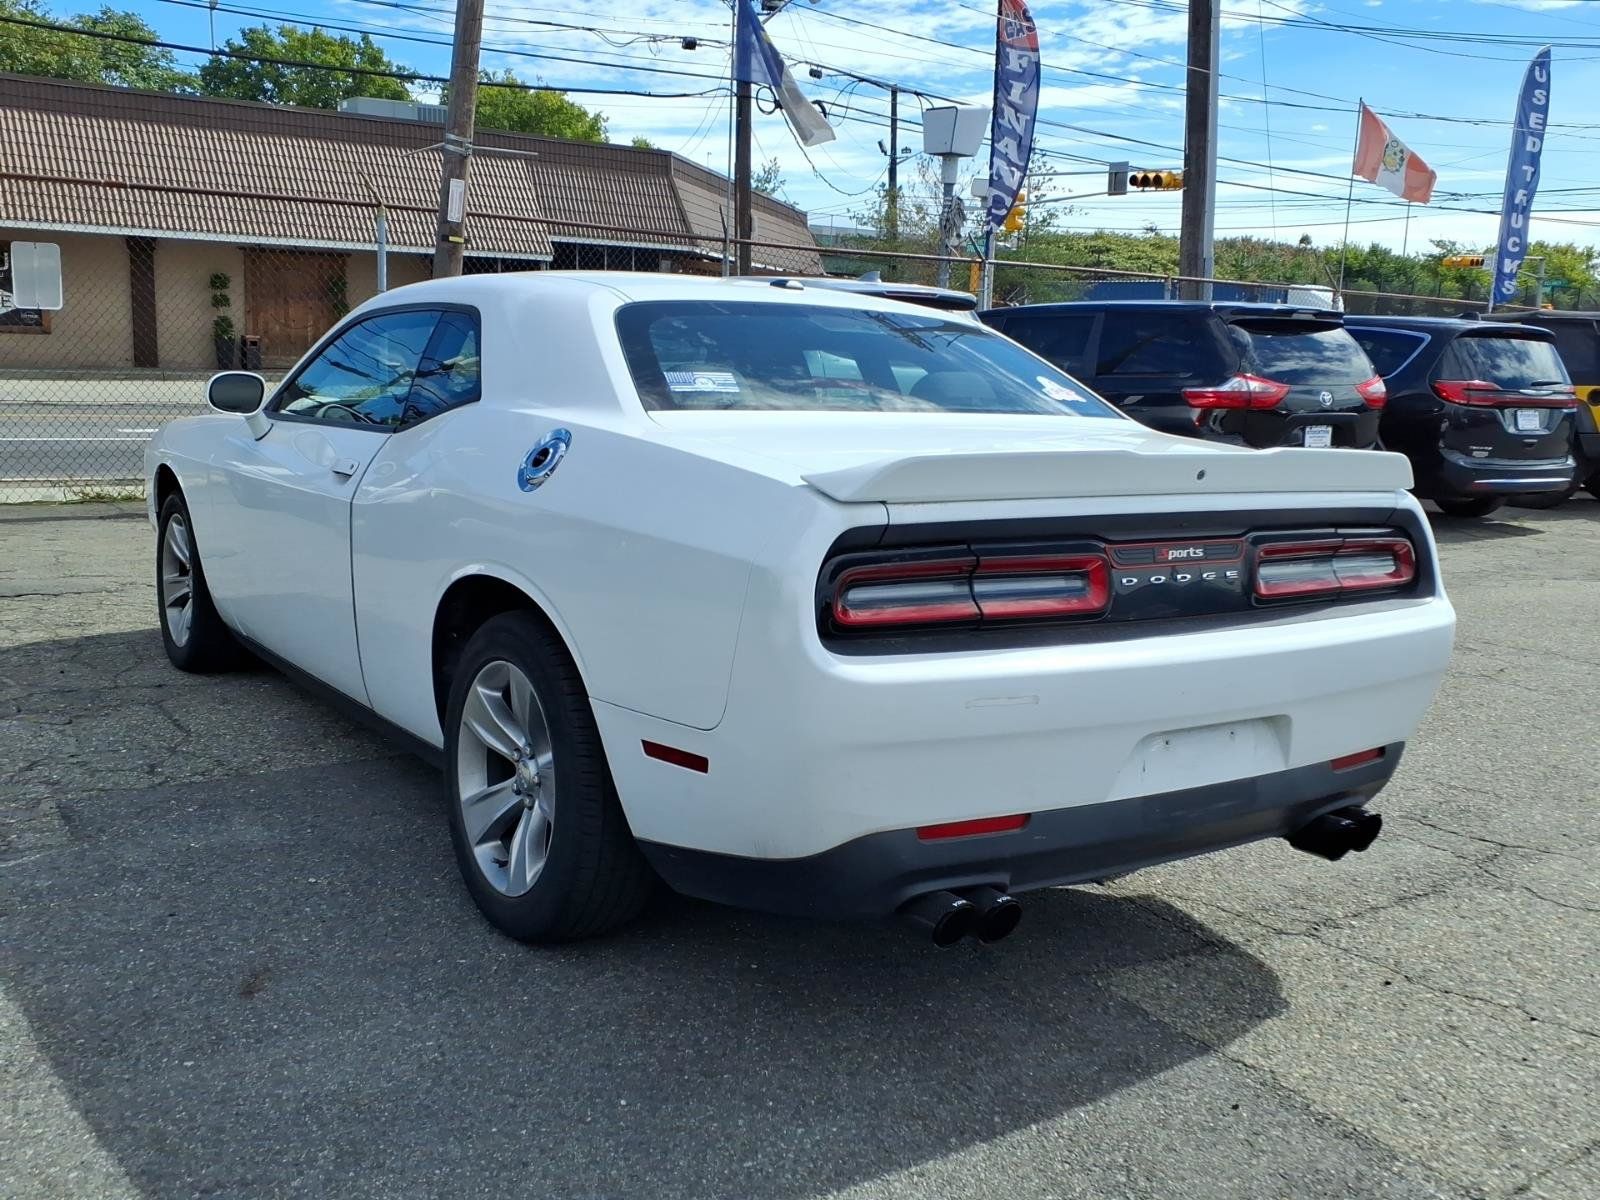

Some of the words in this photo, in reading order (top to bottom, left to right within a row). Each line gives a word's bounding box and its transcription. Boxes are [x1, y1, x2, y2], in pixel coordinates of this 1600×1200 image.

[985, 48, 1039, 233] FINANC
[1524, 65, 1548, 153] USED
[1501, 165, 1536, 296] TRUCKS
[1121, 570, 1239, 586] DODGE
